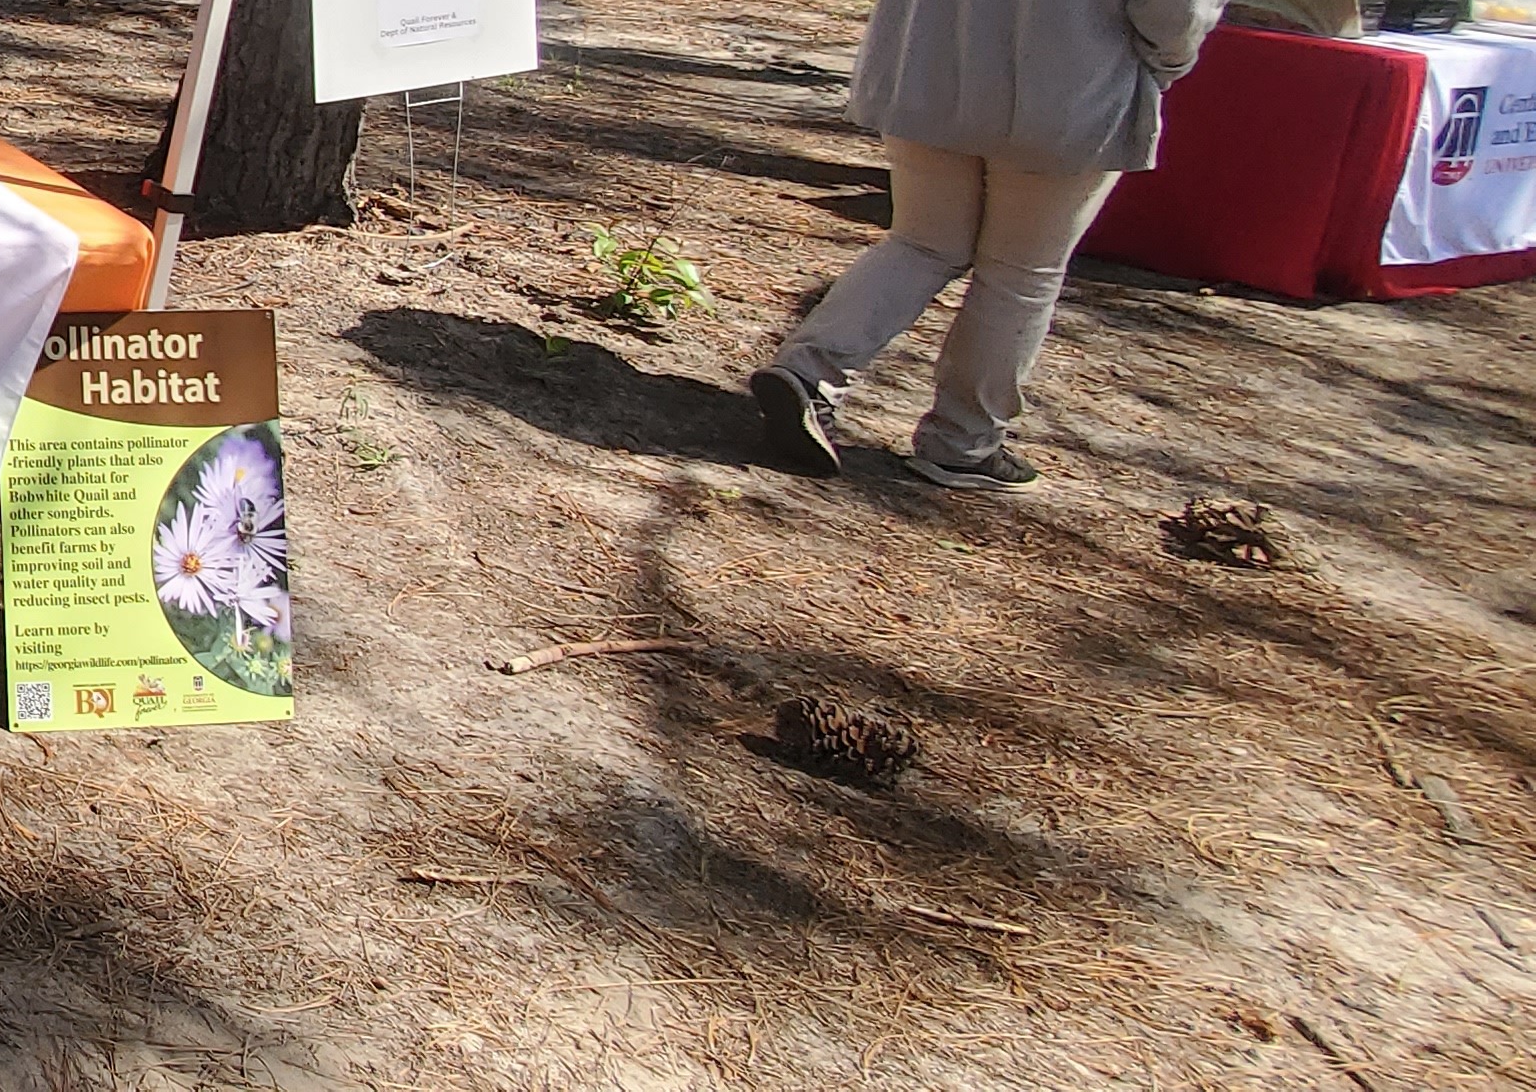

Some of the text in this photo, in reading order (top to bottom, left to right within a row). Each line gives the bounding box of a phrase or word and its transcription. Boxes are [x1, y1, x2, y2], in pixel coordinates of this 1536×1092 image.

[400, 16, 420, 27] Quail
[43, 326, 204, 360] ollinator
[80, 369, 222, 404] Habitat
[8, 436, 189, 453] This area contains pollinator
[7, 453, 163, 471] -friendly plants that also
[8, 472, 129, 488] provide habitat for
[9, 488, 136, 504] Bobwhite Quail and
[9, 506, 114, 523] other songbirds.
[10, 523, 135, 538] Pollinators can also
[11, 540, 115, 556] benefit farms by
[11, 557, 131, 575] improving soil and
[12, 574, 125, 592] water quality and
[13, 591, 150, 608] reducing insect pests.
[14, 622, 110, 638] Learn more by
[14, 642, 63, 656] visiting
